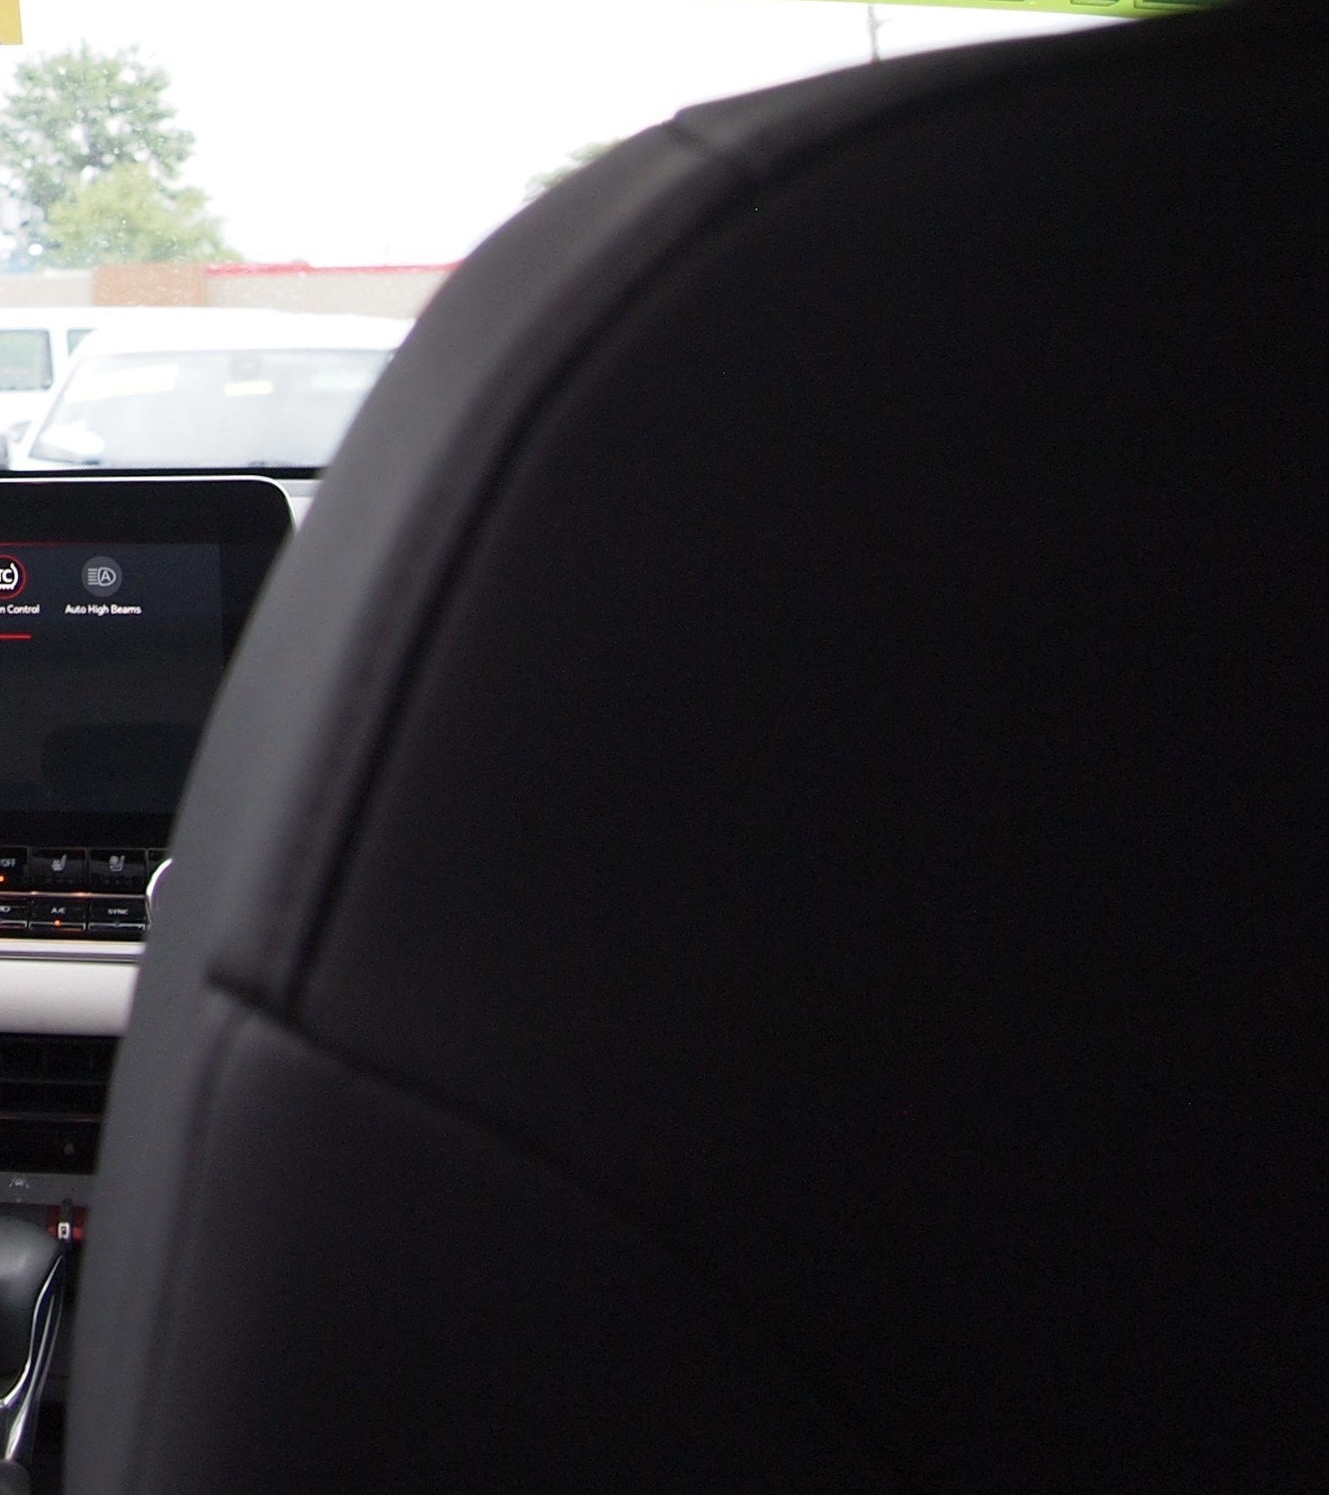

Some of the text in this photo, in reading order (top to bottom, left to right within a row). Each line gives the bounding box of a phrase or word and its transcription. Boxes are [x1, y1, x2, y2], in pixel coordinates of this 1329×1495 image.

[6, 604, 40, 615] Control
[65, 604, 141, 616] Auto High Beams
